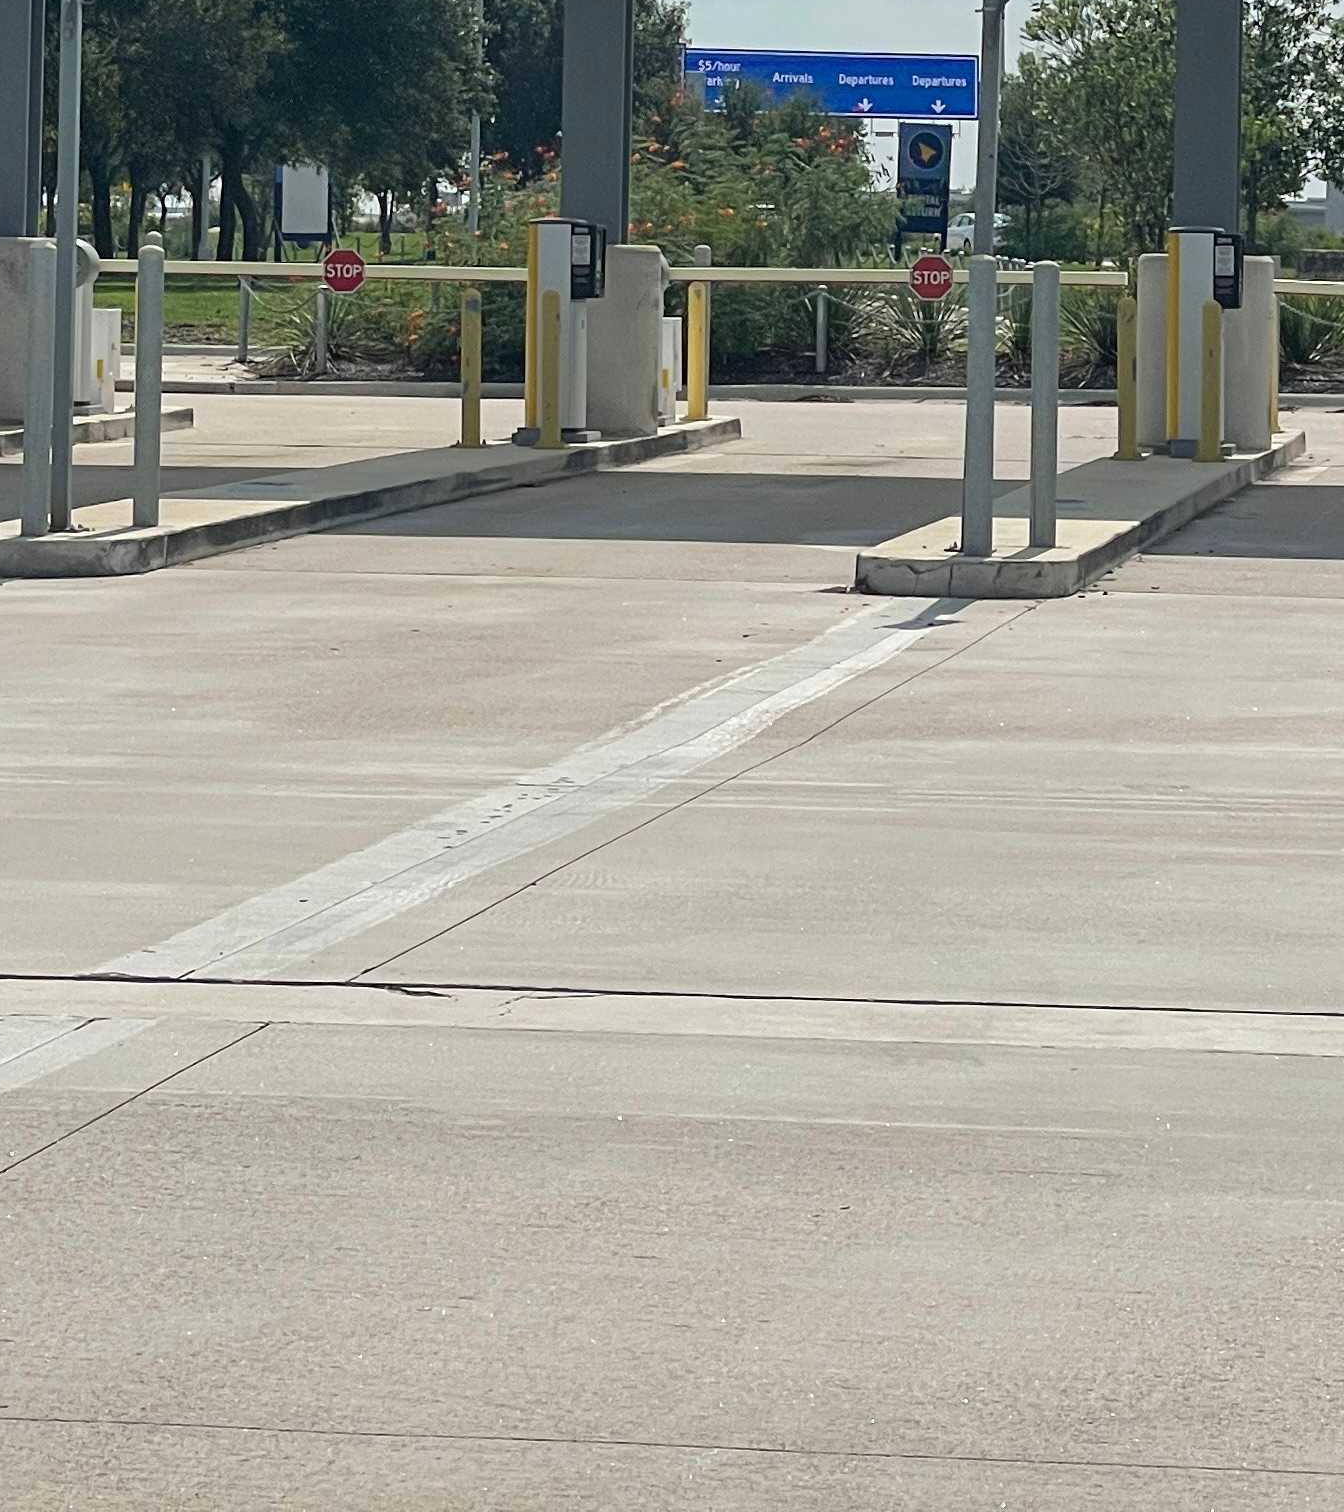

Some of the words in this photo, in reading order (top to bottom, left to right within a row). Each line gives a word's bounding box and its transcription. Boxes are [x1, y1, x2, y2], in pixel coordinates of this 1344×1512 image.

[698, 59, 741, 72] $5/hour
[772, 71, 815, 84] Arrivals
[838, 73, 894, 88] Departures
[911, 75, 967, 89] Departures
[326, 263, 362, 278] STOP
[913, 271, 950, 285] STOP
